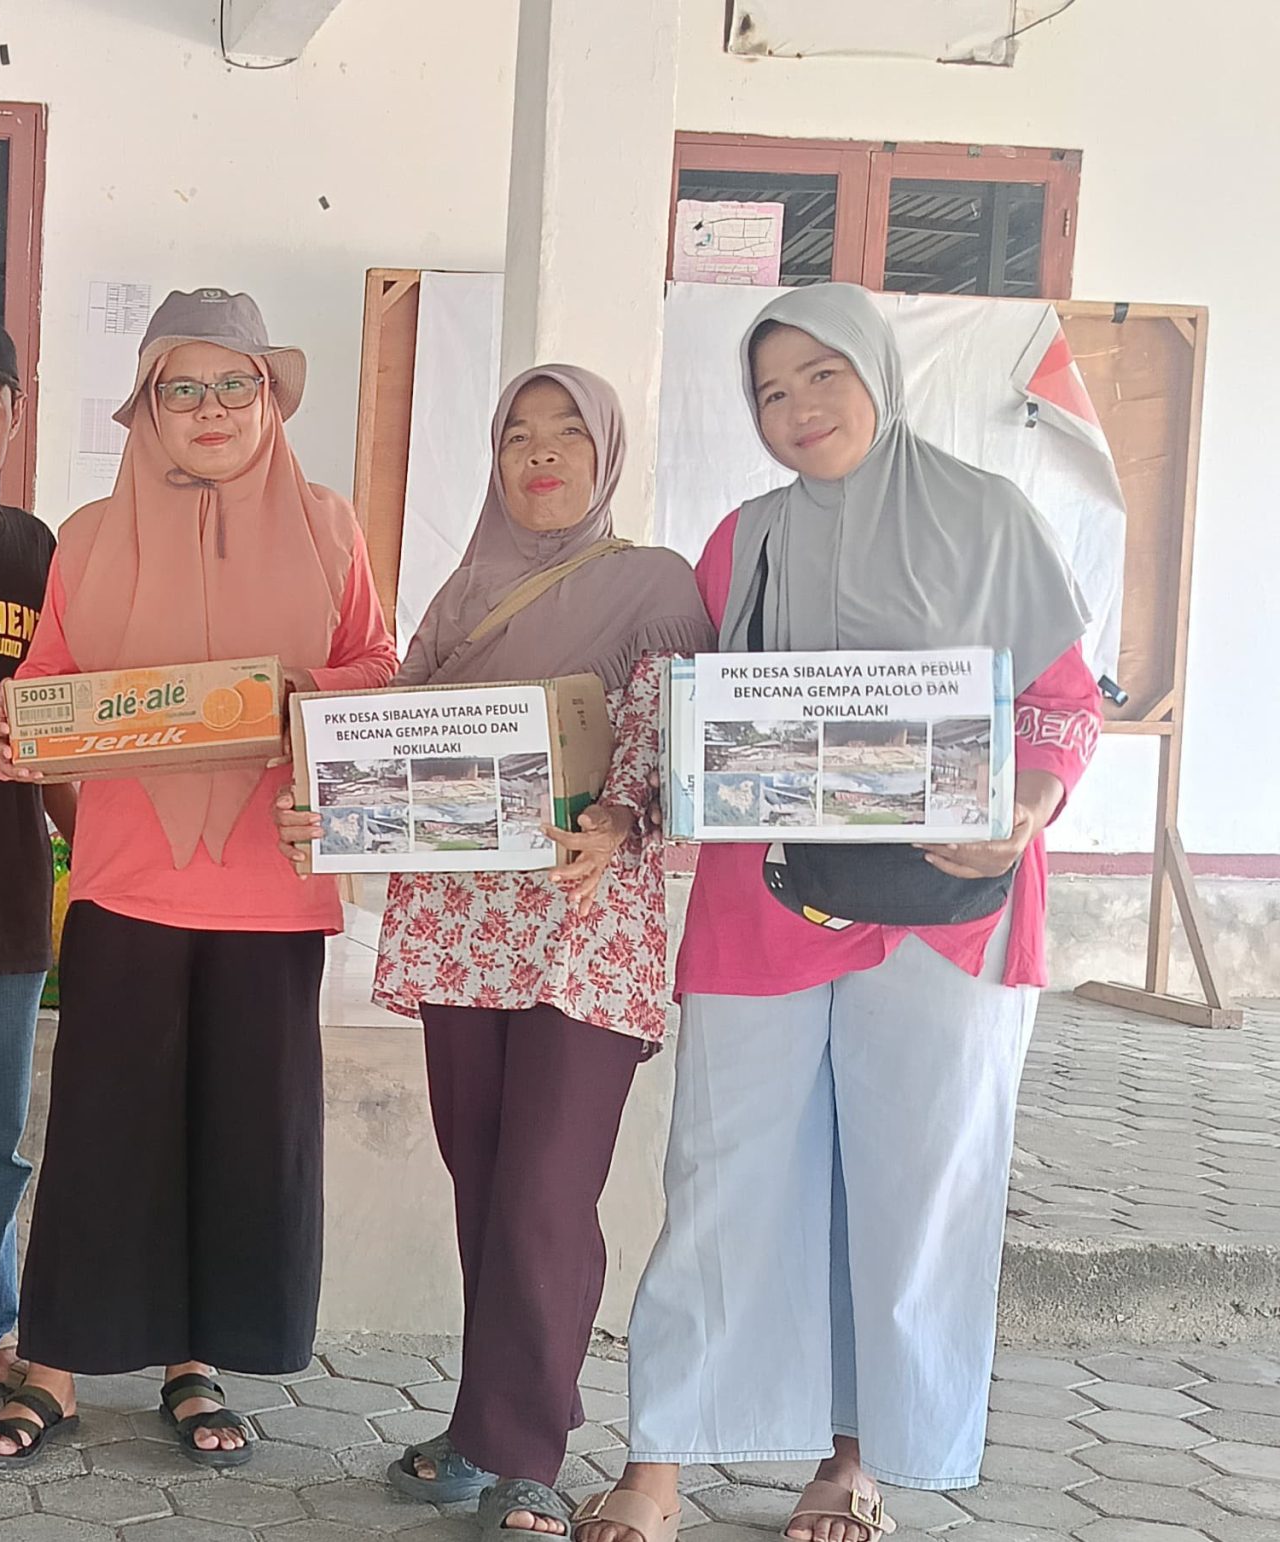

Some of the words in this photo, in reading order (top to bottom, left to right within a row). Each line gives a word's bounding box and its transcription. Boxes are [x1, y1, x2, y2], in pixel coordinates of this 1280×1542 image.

[720, 667, 749, 679] PKK
[752, 667, 789, 679] DESA
[793, 666, 863, 679] SIBALAYA
[867, 664, 917, 678] UTARA
[921, 660, 972, 677] PEDULI
[21, 687, 65, 703] 50031
[733, 686, 803, 698] BENCANA
[807, 685, 860, 697] GEMPA
[865, 683, 922, 697] PALOLO
[926, 680, 959, 695] DAN
[324, 713, 347, 724] PKK
[349, 711, 380, 723] DESA
[382, 707, 439, 722] SIBALAYA
[441, 705, 483, 718] UTARA
[485, 703, 529, 716] PEDULI
[802, 704, 889, 717] NOKILALAKI
[75, 726, 187, 753] Jeruk
[336, 728, 393, 741] BENCANA
[395, 725, 438, 738] GEMPA
[441, 723, 487, 736] PALOLO
[491, 721, 519, 734] DAN
[22, 745, 35, 755] 15
[393, 742, 462, 755] NOKILALAKI
